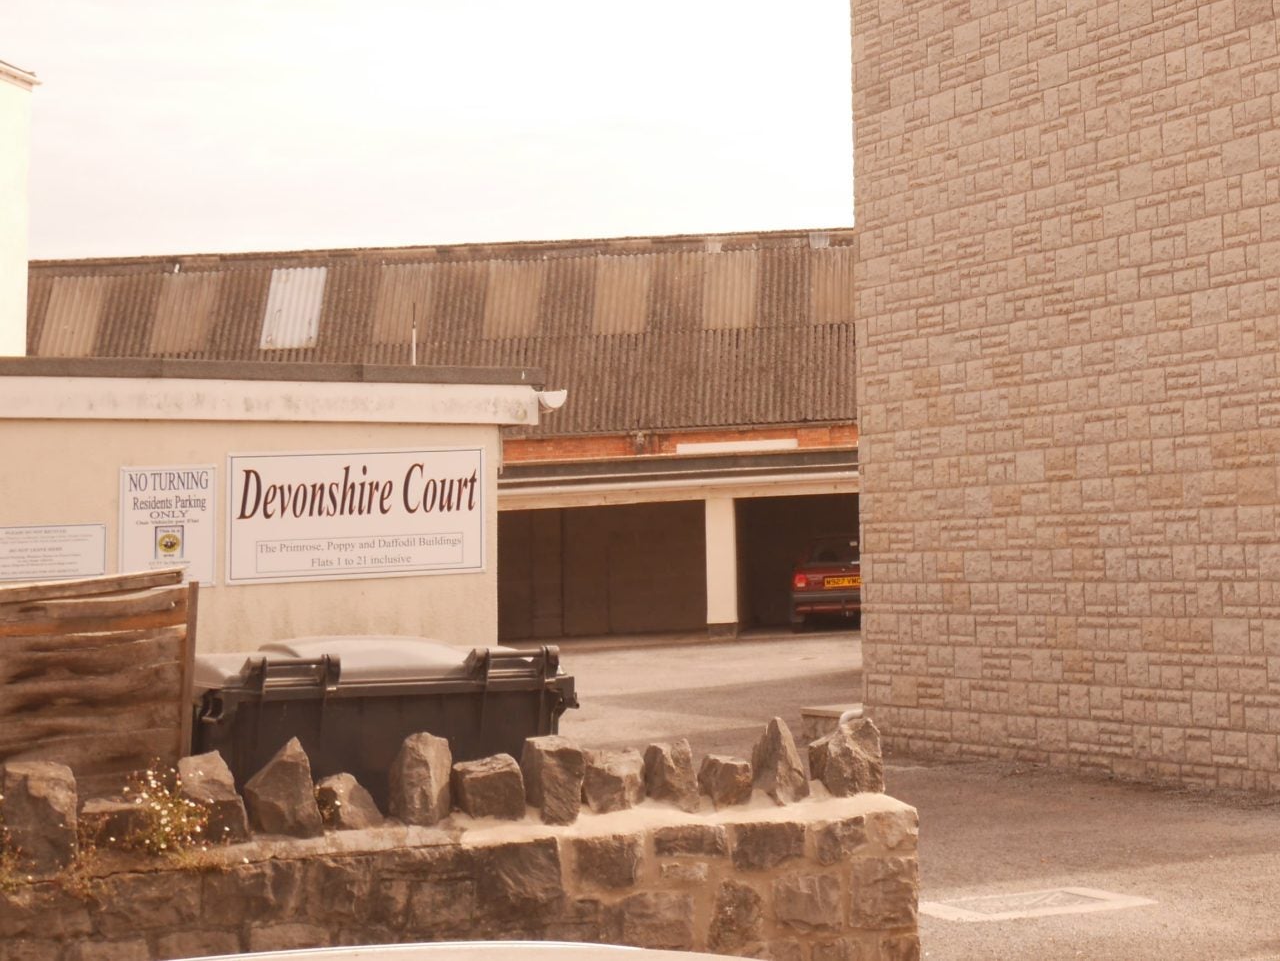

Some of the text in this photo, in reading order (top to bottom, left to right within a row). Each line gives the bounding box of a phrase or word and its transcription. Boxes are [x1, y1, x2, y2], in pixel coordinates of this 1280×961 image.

[128, 471, 209, 492] NO TURNING
[236, 463, 478, 520] Devonshire Court
[133, 495, 206, 511] Residents Parking
[149, 511, 188, 519] ONLY
[259, 536, 462, 554] The Primrose, Poppy and Daffodil Buildings
[311, 554, 412, 568] Flats 1 to 21 inclusive
